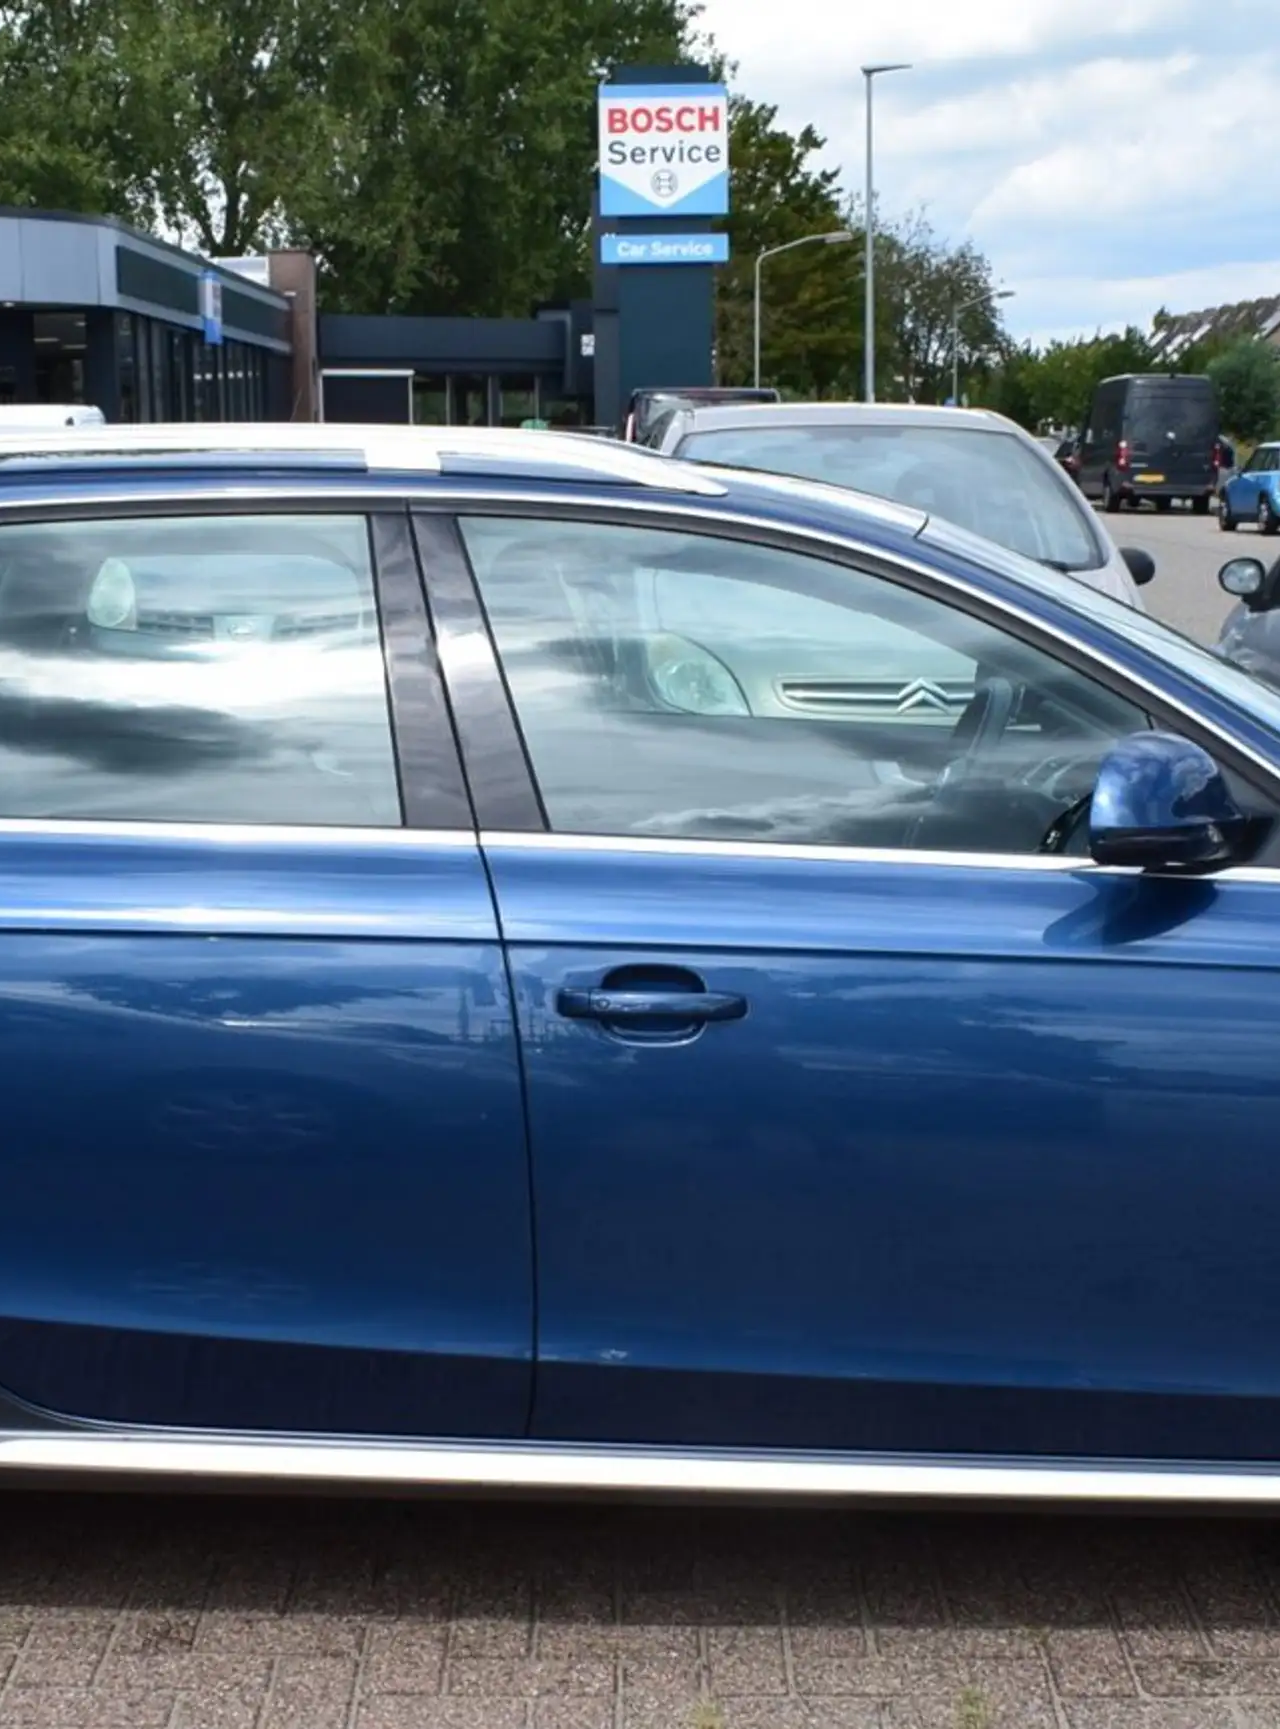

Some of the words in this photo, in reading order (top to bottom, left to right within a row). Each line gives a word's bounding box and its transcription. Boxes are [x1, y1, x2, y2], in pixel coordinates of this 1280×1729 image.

[607, 106, 720, 133] BOSCH
[607, 140, 721, 165] Service
[617, 241, 646, 257] Car
[651, 240, 714, 257] Service
